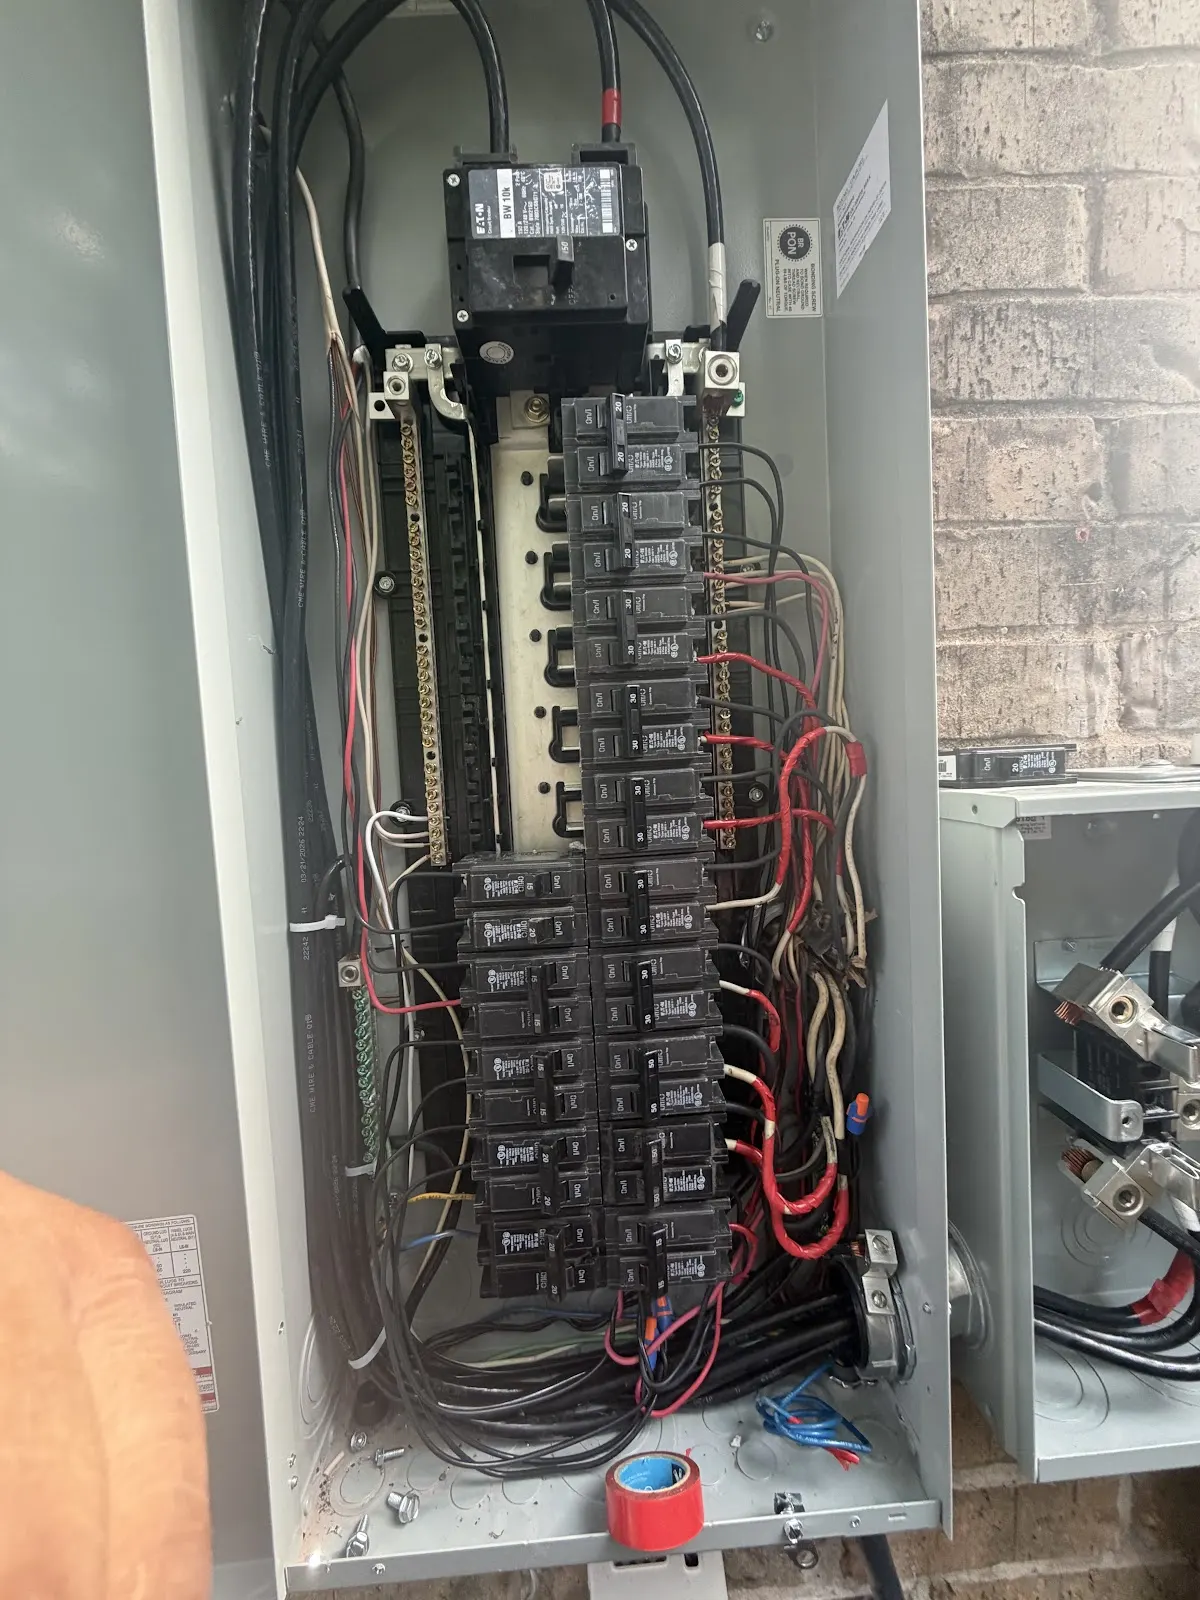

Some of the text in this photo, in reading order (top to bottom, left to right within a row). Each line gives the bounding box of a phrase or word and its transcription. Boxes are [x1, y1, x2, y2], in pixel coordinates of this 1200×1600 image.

[502, 186, 512, 220] BW 10k
[475, 203, 486, 235] EATON
[560, 241, 570, 255] 150
[787, 231, 797, 255] PON
[798, 238, 804, 248] BR
[615, 401, 622, 412] 20
[585, 408, 593, 425] On/I
[617, 451, 625, 463] 20
[622, 501, 629, 513] 20
[591, 505, 599, 521] On/I
[624, 548, 631, 559] 20
[625, 598, 632, 609] 30
[628, 645, 635, 656] 30
[630, 693, 637, 704] 30
[632, 739, 639, 751] 30
[1011, 762, 1019, 773] 20
[634, 784, 642, 796] 30
[602, 828, 610, 843] On/I
[637, 832, 644, 842] 30
[298, 838, 307, 883] 03/21/2026
[526, 882, 533, 891] 15
[604, 874, 612, 889] On/I
[637, 879, 644, 889] 30
[529, 927, 537, 938] 20
[555, 920, 563, 936] On/I
[640, 924, 647, 935] 30
[302, 936, 310, 961] 22242
[561, 965, 569, 980] On/I
[608, 963, 616, 979] On/I
[641, 969, 648, 980] 30
[531, 975, 538, 983] 15
[564, 1007, 572, 1022] On/I
[611, 1007, 619, 1022] On/I
[644, 1014, 651, 1024] 30
[534, 1019, 541, 1027] 15
[306, 1033, 315, 1061] CABLE
[567, 1053, 575, 1068] On/I
[648, 1058, 655, 1069] 50
[538, 1063, 545, 1071] 15
[308, 1072, 316, 1093] WIRE
[617, 1097, 625, 1112] On/I
[651, 1103, 657, 1113] 50
[540, 1107, 547, 1116] 15
[572, 1141, 580, 1156] On/I
[652, 1148, 658, 1158] 50
[542, 1153, 549, 1163] 20
[574, 1183, 582, 1198] On/I
[544, 1195, 551, 1206] 20
[654, 1193, 660, 1202] 50
[576, 1228, 584, 1243] On/I
[548, 1242, 556, 1252] 20
[656, 1238, 662, 1247] 15
[578, 1269, 586, 1284] On/I
[551, 1284, 558, 1295] 20
[658, 1280, 665, 1289] 15
